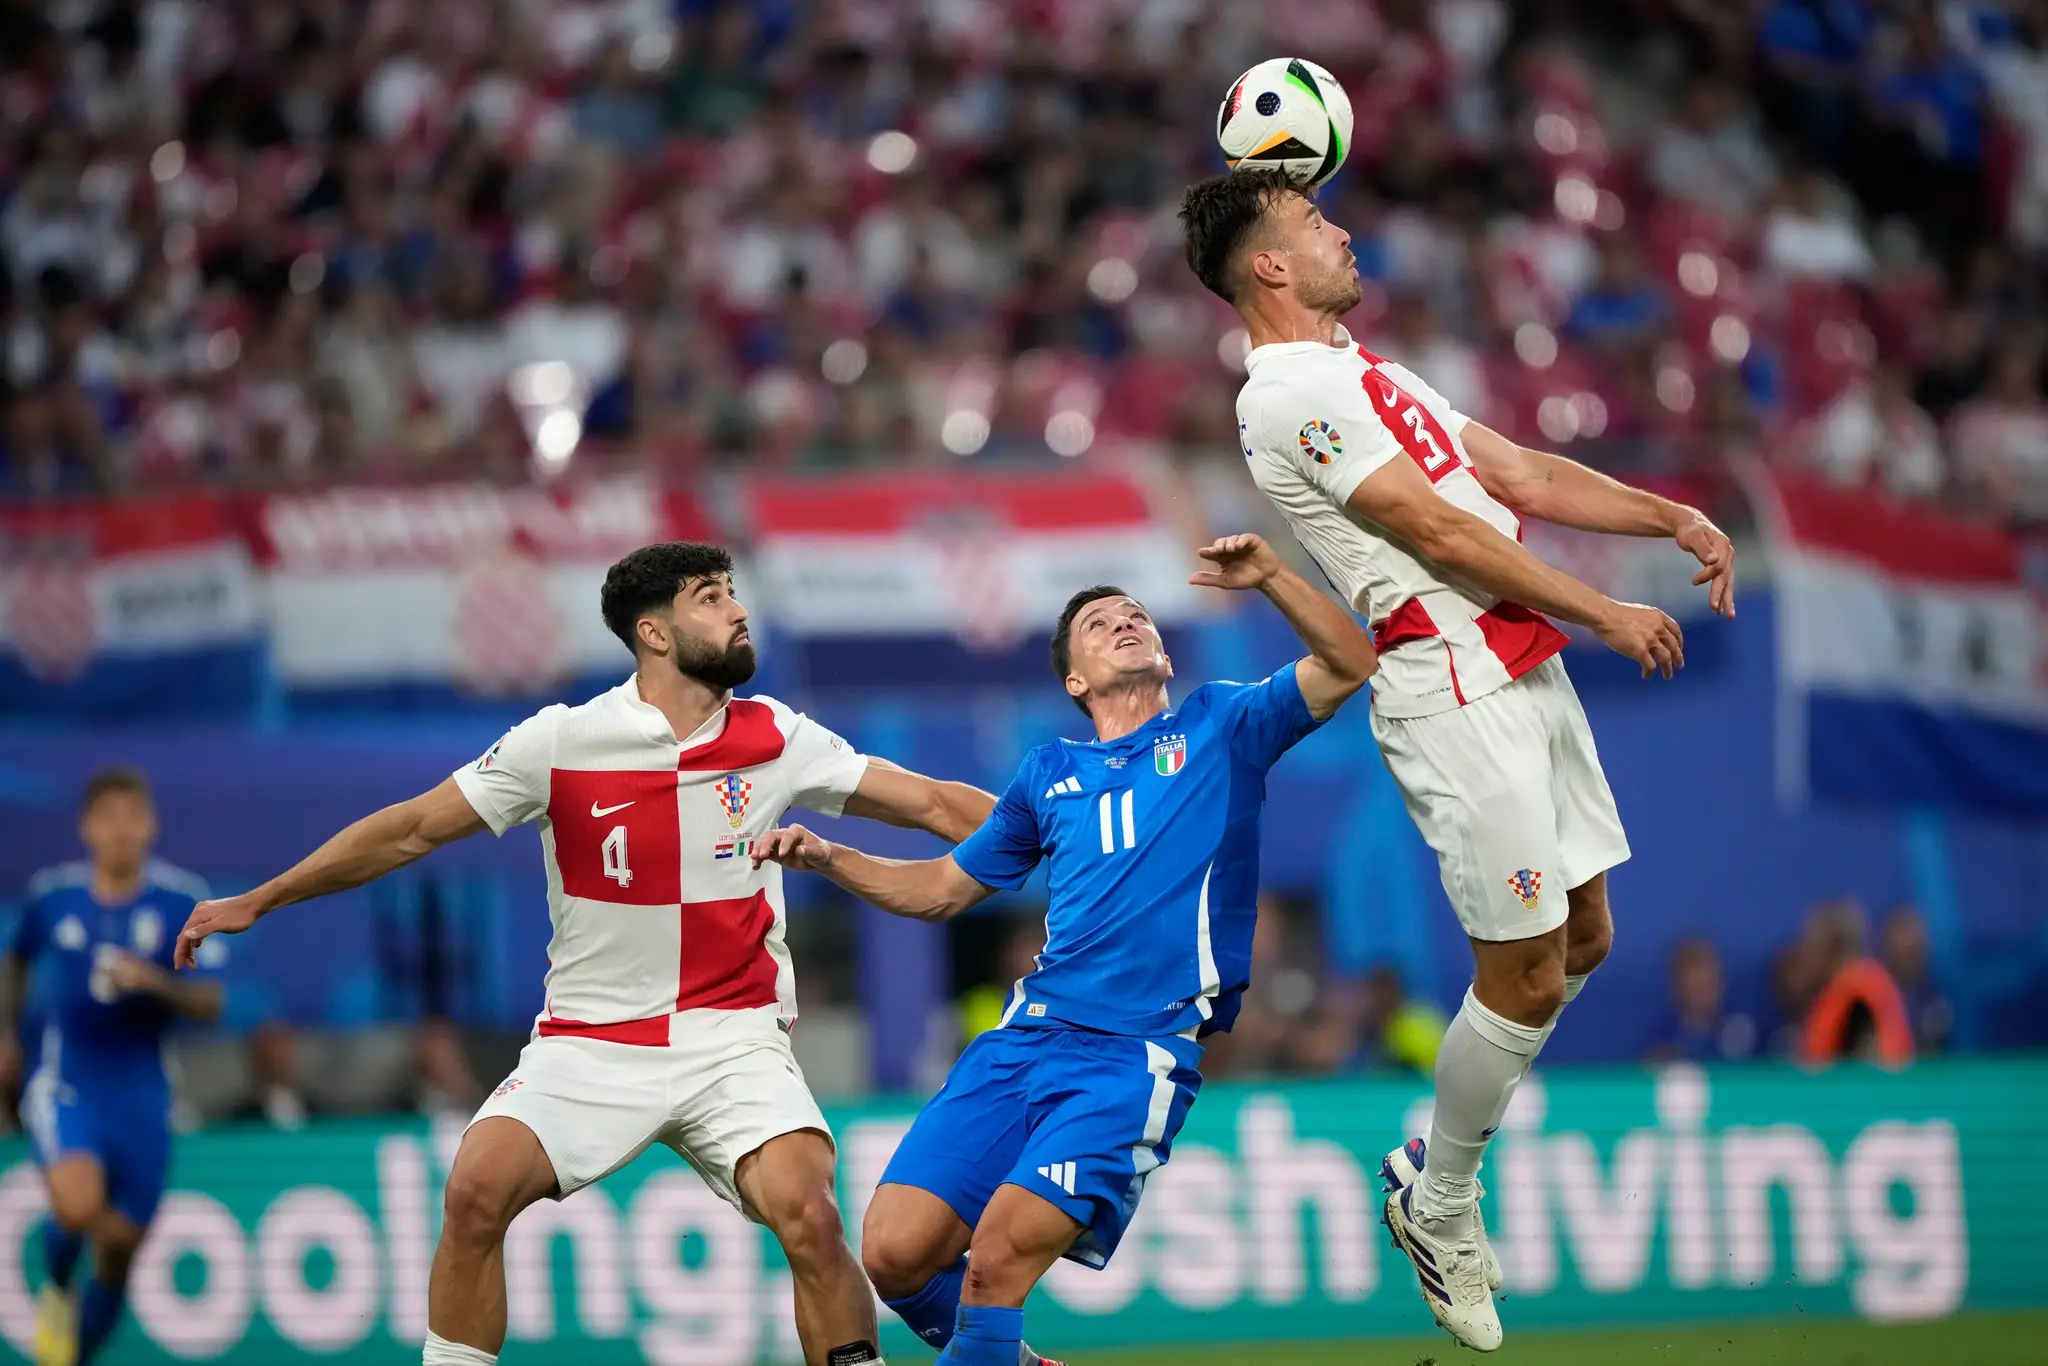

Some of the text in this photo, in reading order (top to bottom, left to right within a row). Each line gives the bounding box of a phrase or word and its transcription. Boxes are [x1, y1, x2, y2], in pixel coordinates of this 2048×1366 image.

[1401, 405, 1450, 471] 3
[1157, 742, 1183, 754] ITALIA
[1099, 788, 1136, 855] 11
[601, 825, 633, 888] 4
[1403, 1062, 1969, 1323] iving
